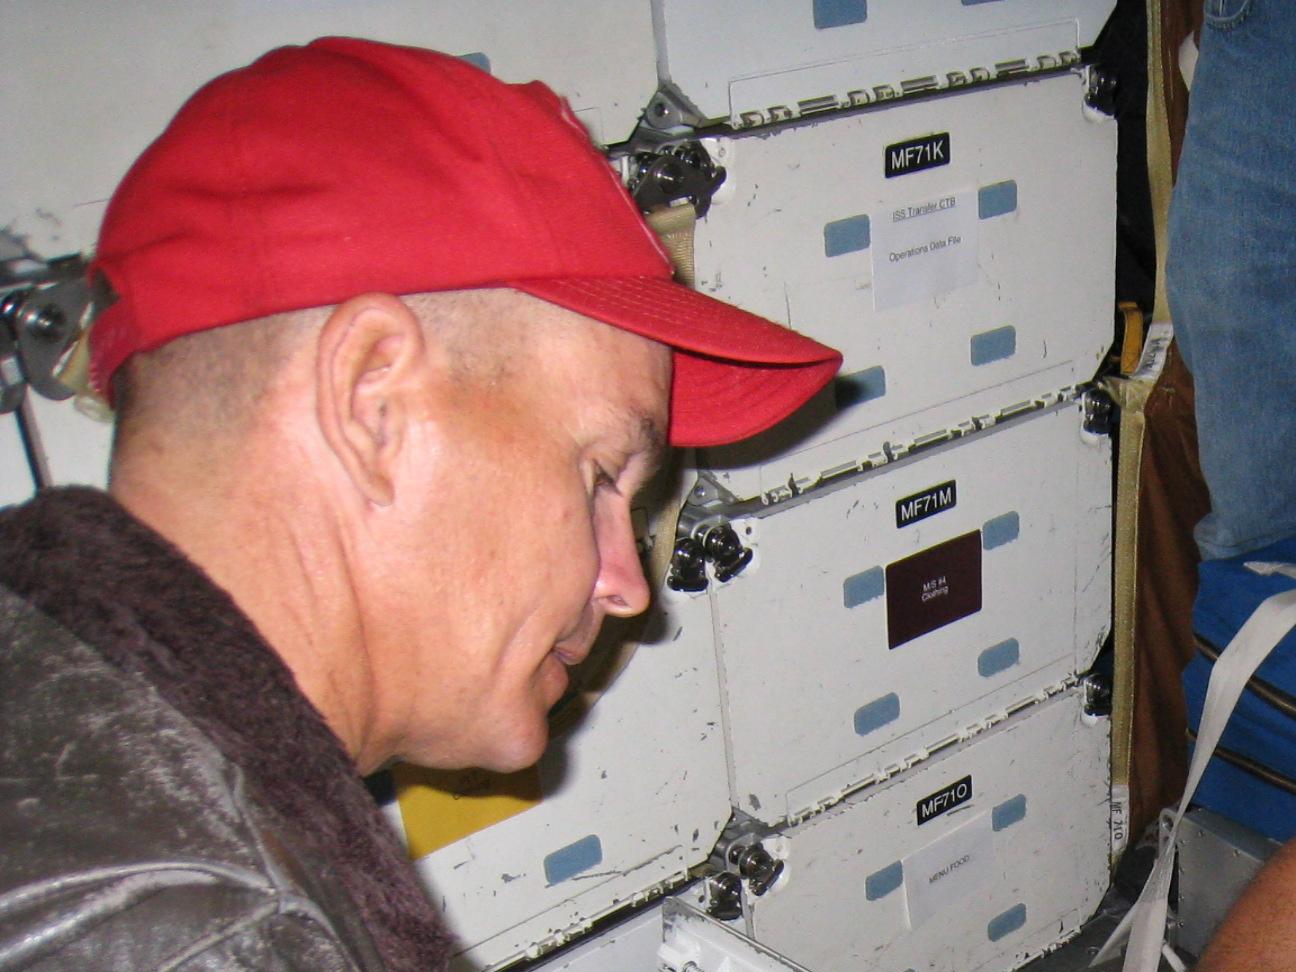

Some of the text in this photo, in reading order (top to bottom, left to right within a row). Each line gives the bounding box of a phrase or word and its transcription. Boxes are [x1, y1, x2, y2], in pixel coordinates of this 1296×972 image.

[891, 140, 945, 171] MF71K
[892, 196, 956, 223] ISS Transfer CTB
[889, 235, 962, 262] Operations Data File
[900, 486, 953, 522] MF71M
[921, 585, 949, 602] Clothing
[928, 854, 970, 884] MENU FOOD
